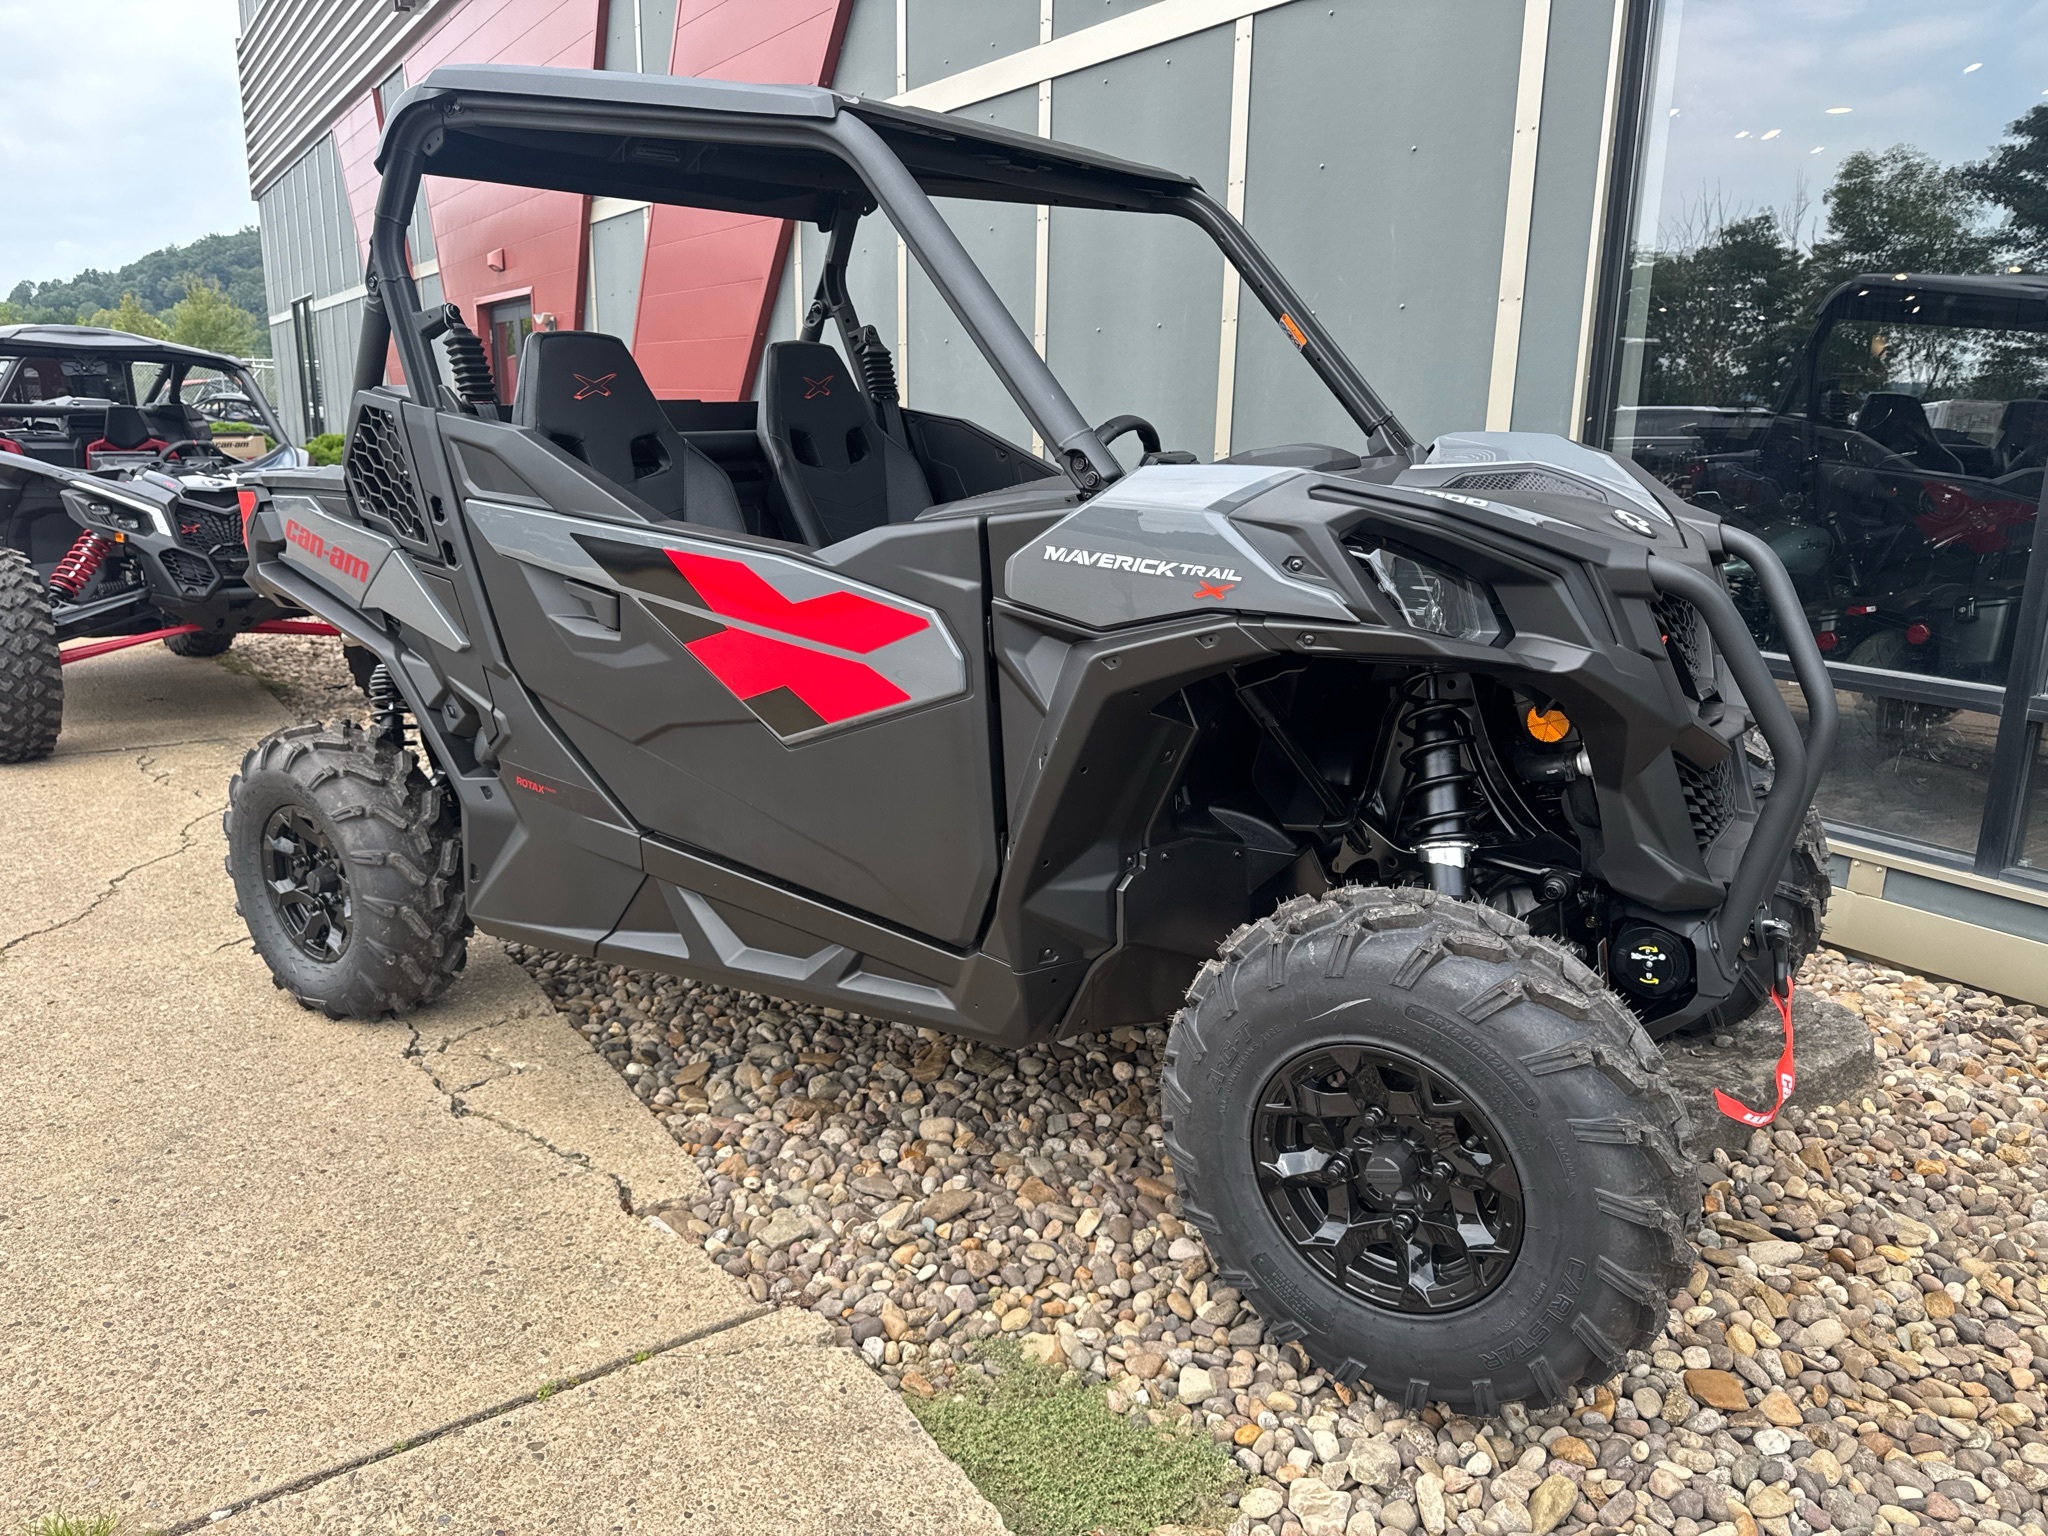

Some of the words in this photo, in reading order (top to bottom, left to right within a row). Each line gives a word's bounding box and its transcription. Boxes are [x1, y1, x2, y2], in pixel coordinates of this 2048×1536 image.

[285, 518, 370, 583] can-am
[1043, 545, 1180, 577] MAVERICK
[1179, 563, 1243, 582] TRAIL
[516, 775, 545, 795] ROTAX
[1260, 1024, 1282, 1041] TIRE
[1478, 1256, 1587, 1371] CARLSTAR
